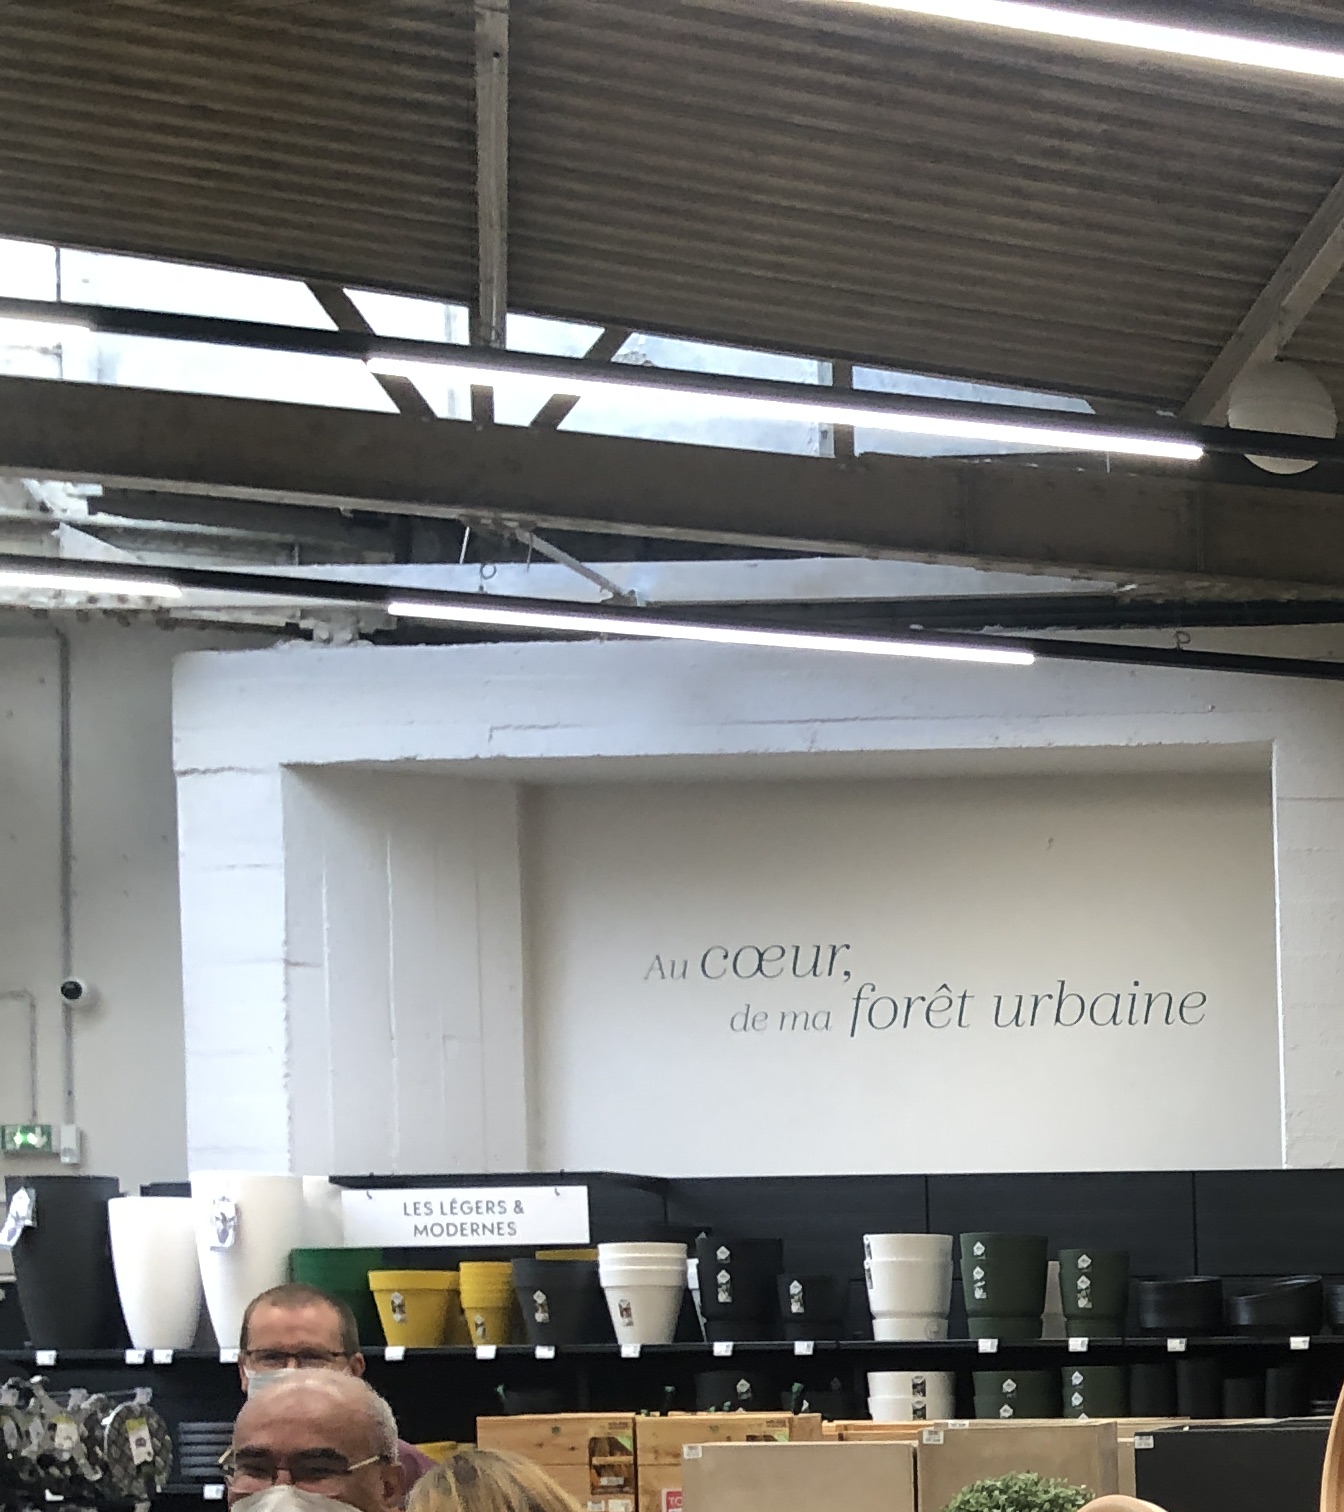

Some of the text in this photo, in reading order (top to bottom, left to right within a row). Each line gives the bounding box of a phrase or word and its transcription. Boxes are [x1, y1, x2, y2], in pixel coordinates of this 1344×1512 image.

[643, 953, 689, 981] Au
[729, 979, 1209, 1037] de ma forêt urbaine
[403, 1197, 525, 1217] LES LÉGERS &
[413, 1220, 517, 1238] MODERNES
